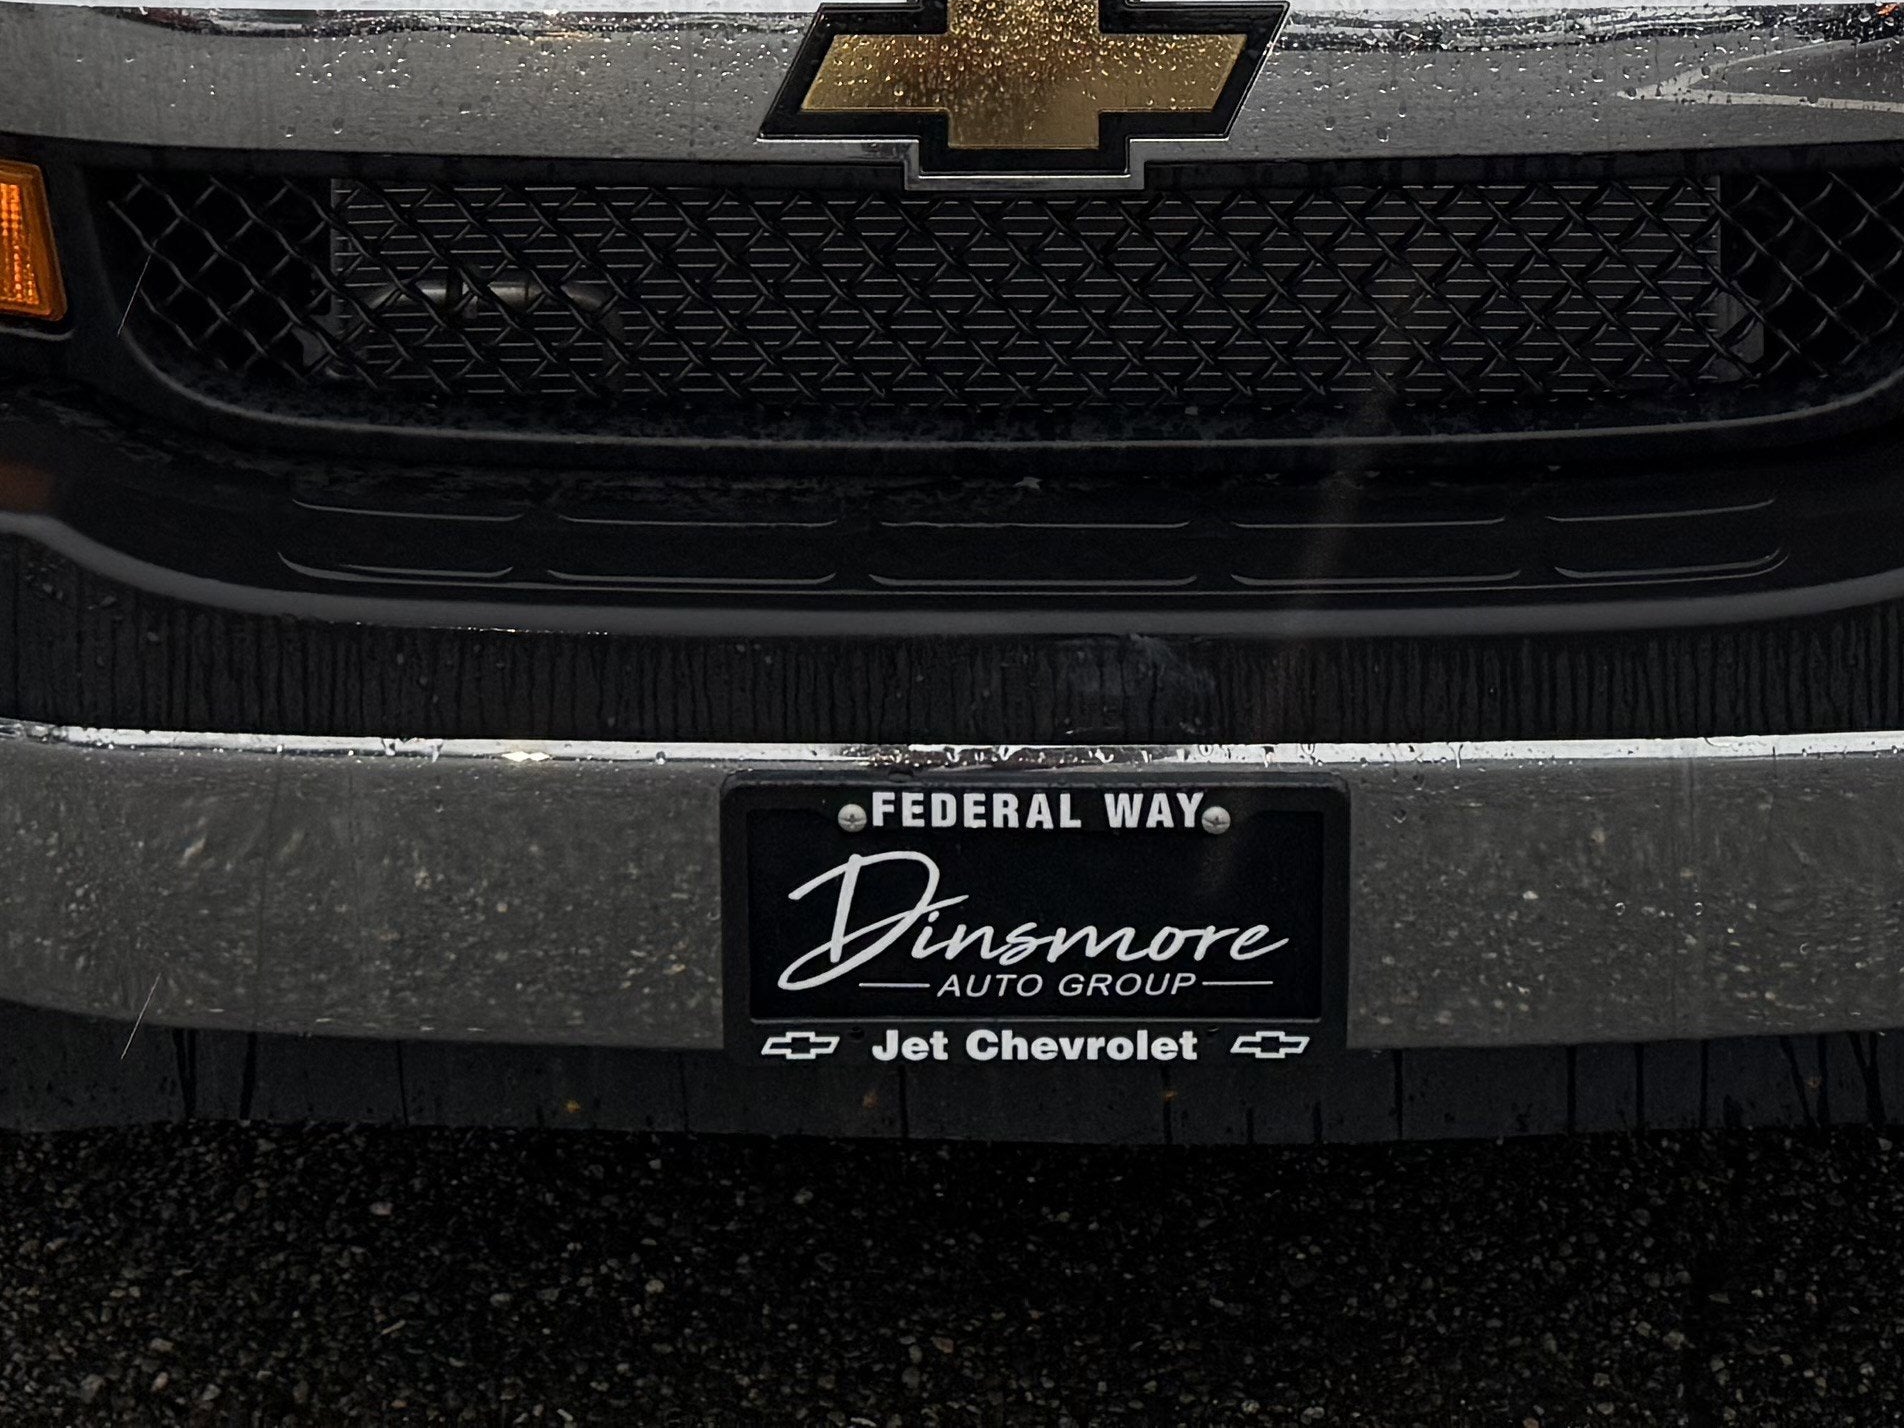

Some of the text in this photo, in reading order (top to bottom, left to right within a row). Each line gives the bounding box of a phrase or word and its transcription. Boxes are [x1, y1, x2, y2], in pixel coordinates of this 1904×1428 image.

[872, 792, 1204, 829] FEDERAL WAY
[777, 850, 1290, 991] Dinsmore
[937, 972, 1197, 997] AUTO GROUP
[871, 1029, 1199, 1062] Jet Chevrolet
